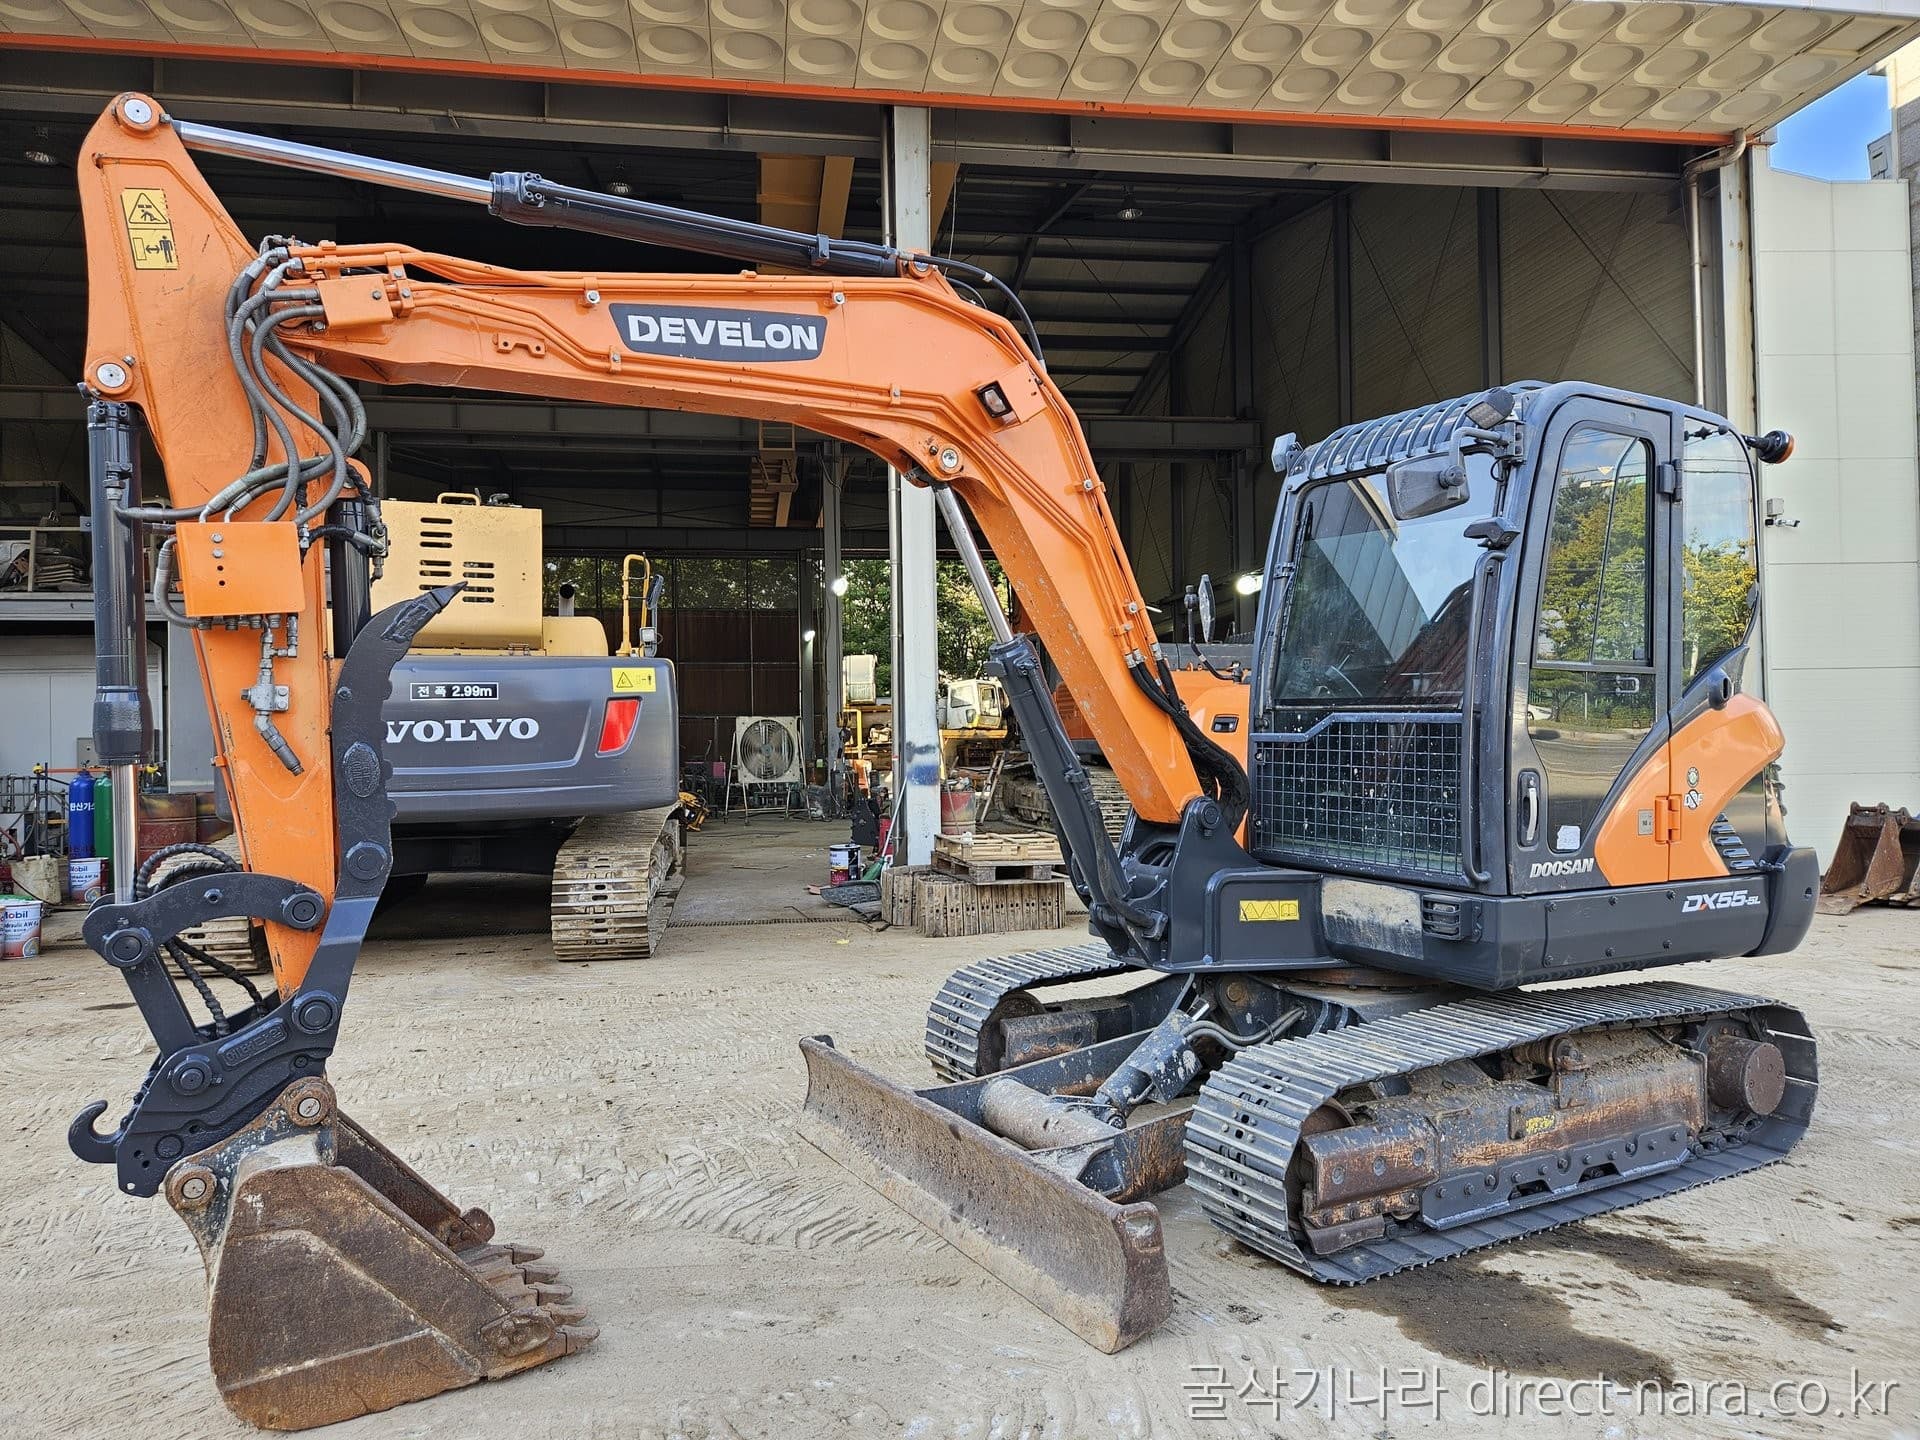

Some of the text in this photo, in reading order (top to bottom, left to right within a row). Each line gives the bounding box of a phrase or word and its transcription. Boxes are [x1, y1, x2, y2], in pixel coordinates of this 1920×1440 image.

[627, 314, 818, 351] DEVELON
[417, 685, 430, 698] 전
[452, 685, 493, 697] 2.99m
[385, 717, 540, 744] VOLVO
[1529, 858, 1595, 878] DOOSAN
[1681, 889, 1761, 913] DX55-5L
